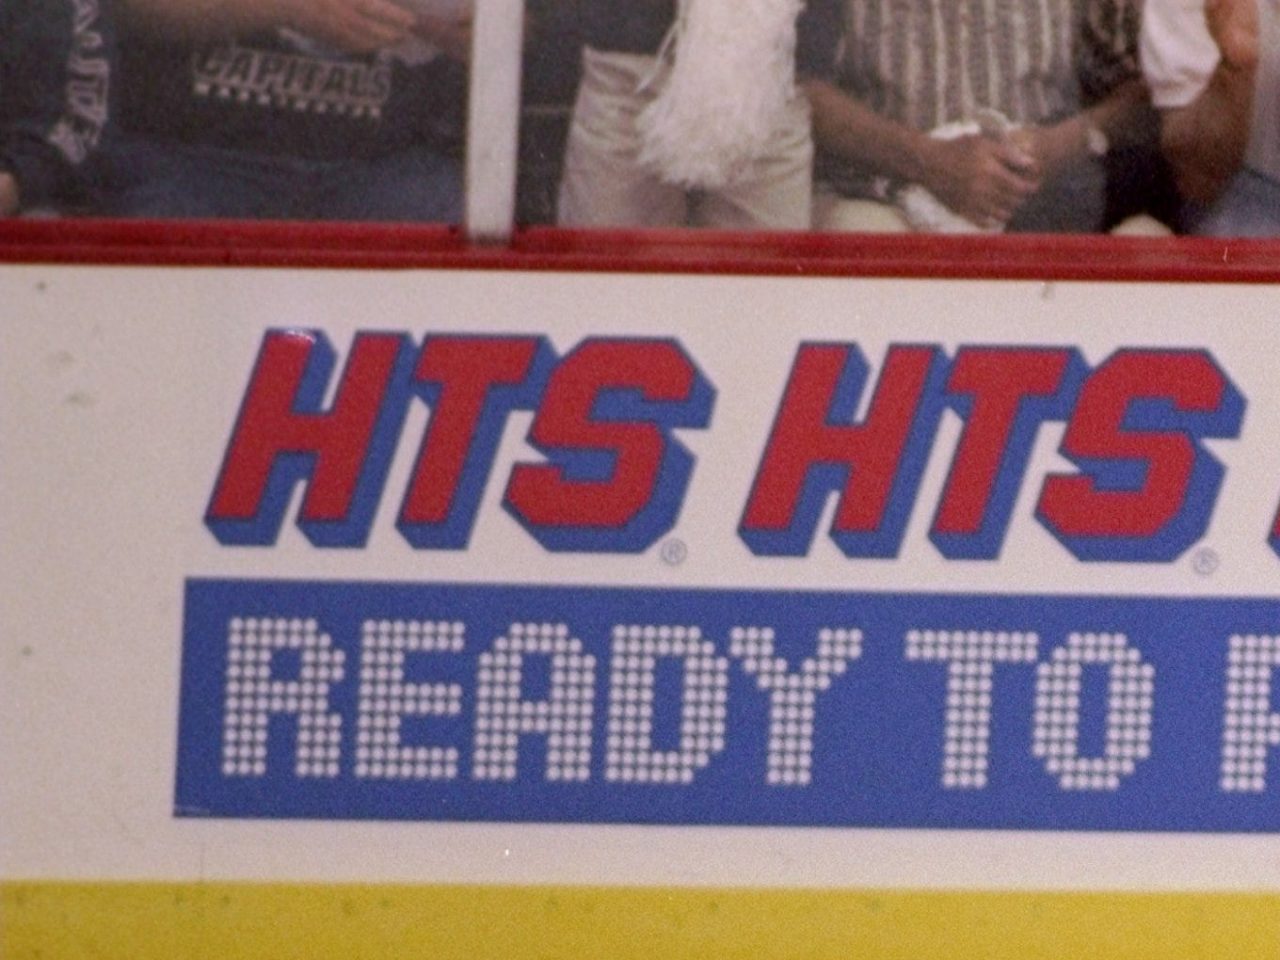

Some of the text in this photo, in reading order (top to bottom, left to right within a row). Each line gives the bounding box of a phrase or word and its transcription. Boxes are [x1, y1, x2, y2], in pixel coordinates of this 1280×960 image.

[204, 328, 717, 554] HTS
[737, 341, 1248, 563] HTS
[222, 617, 863, 786] READY
[905, 629, 1155, 790] TO
